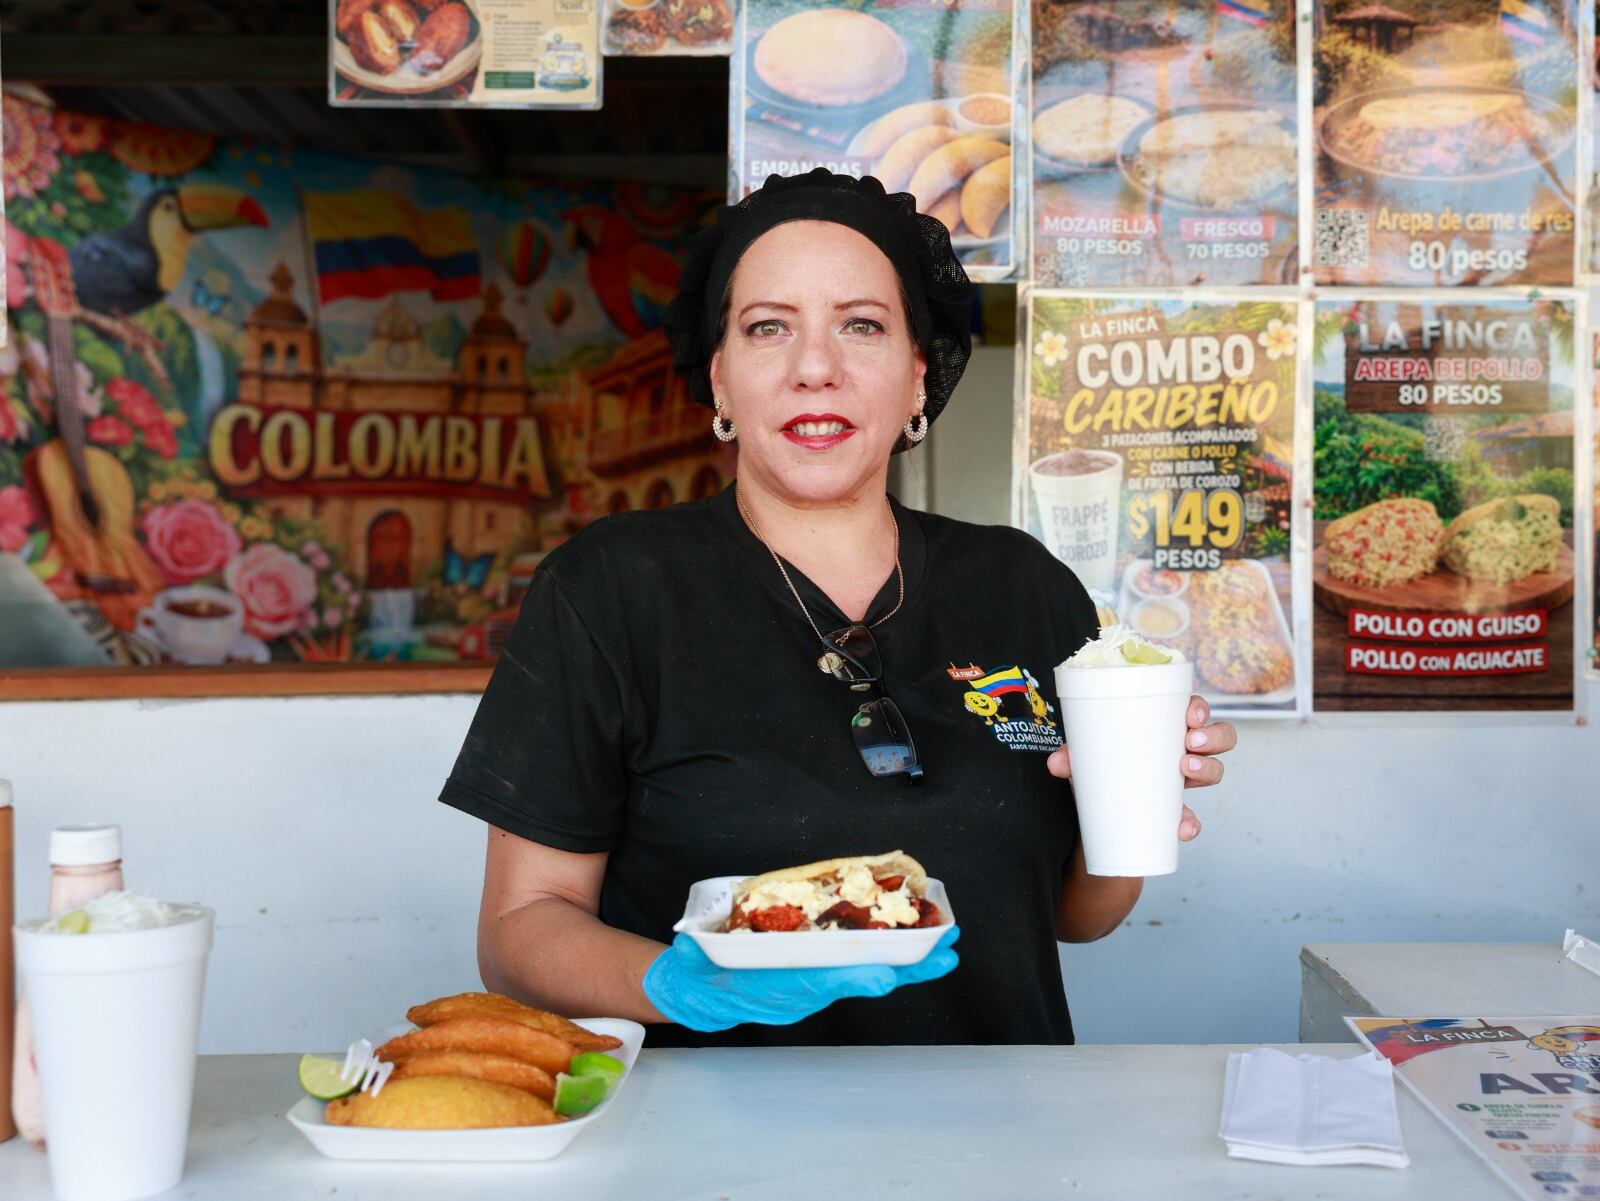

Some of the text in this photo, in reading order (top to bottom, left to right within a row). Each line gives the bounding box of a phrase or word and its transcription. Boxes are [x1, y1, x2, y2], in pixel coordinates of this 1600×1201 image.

[751, 160, 861, 179] EMPANDAS
[1043, 215, 1157, 235] MOZARELLA
[1193, 220, 1263, 237] FRESCO
[1376, 206, 1574, 236] Arepa de carne de res
[1056, 238, 1143, 256] 80 PESOS
[1187, 242, 1269, 259] 70 PESOS
[1408, 240, 1528, 276] 80 pesos
[1079, 316, 1159, 339] LA FINCA
[1359, 319, 1538, 352] LA FINCA
[1076, 333, 1255, 389] COMBO
[1354, 357, 1543, 381] AREPA DE POLLO
[1398, 384, 1503, 405] 80 PESOS
[1063, 376, 1278, 434] CARIBEÑO
[1102, 426, 1258, 448] 3 PATACONES ACOMPAÑADOS
[208, 403, 553, 498] COLOMBIA
[1128, 444, 1237, 460] CON CARNE O POLLO
[1150, 460, 1215, 475] CON BEBIDA
[1127, 474, 1241, 490] DE FRUTA DE COROZO
[1128, 489, 1245, 548] $149
[1075, 529, 1089, 542] DE
[1059, 540, 1108, 562] COROZO
[1154, 549, 1221, 569] PESOS
[1354, 613, 1541, 638] POLLO CON GUISO
[1350, 648, 1545, 671] POLLO CON AGUACATE
[952, 669, 981, 678] LA FINCA
[994, 720, 1057, 736] ANTOJITOS
[996, 733, 1064, 745] COLOMBIANOS
[1406, 1029, 1515, 1043] LA FINCA
